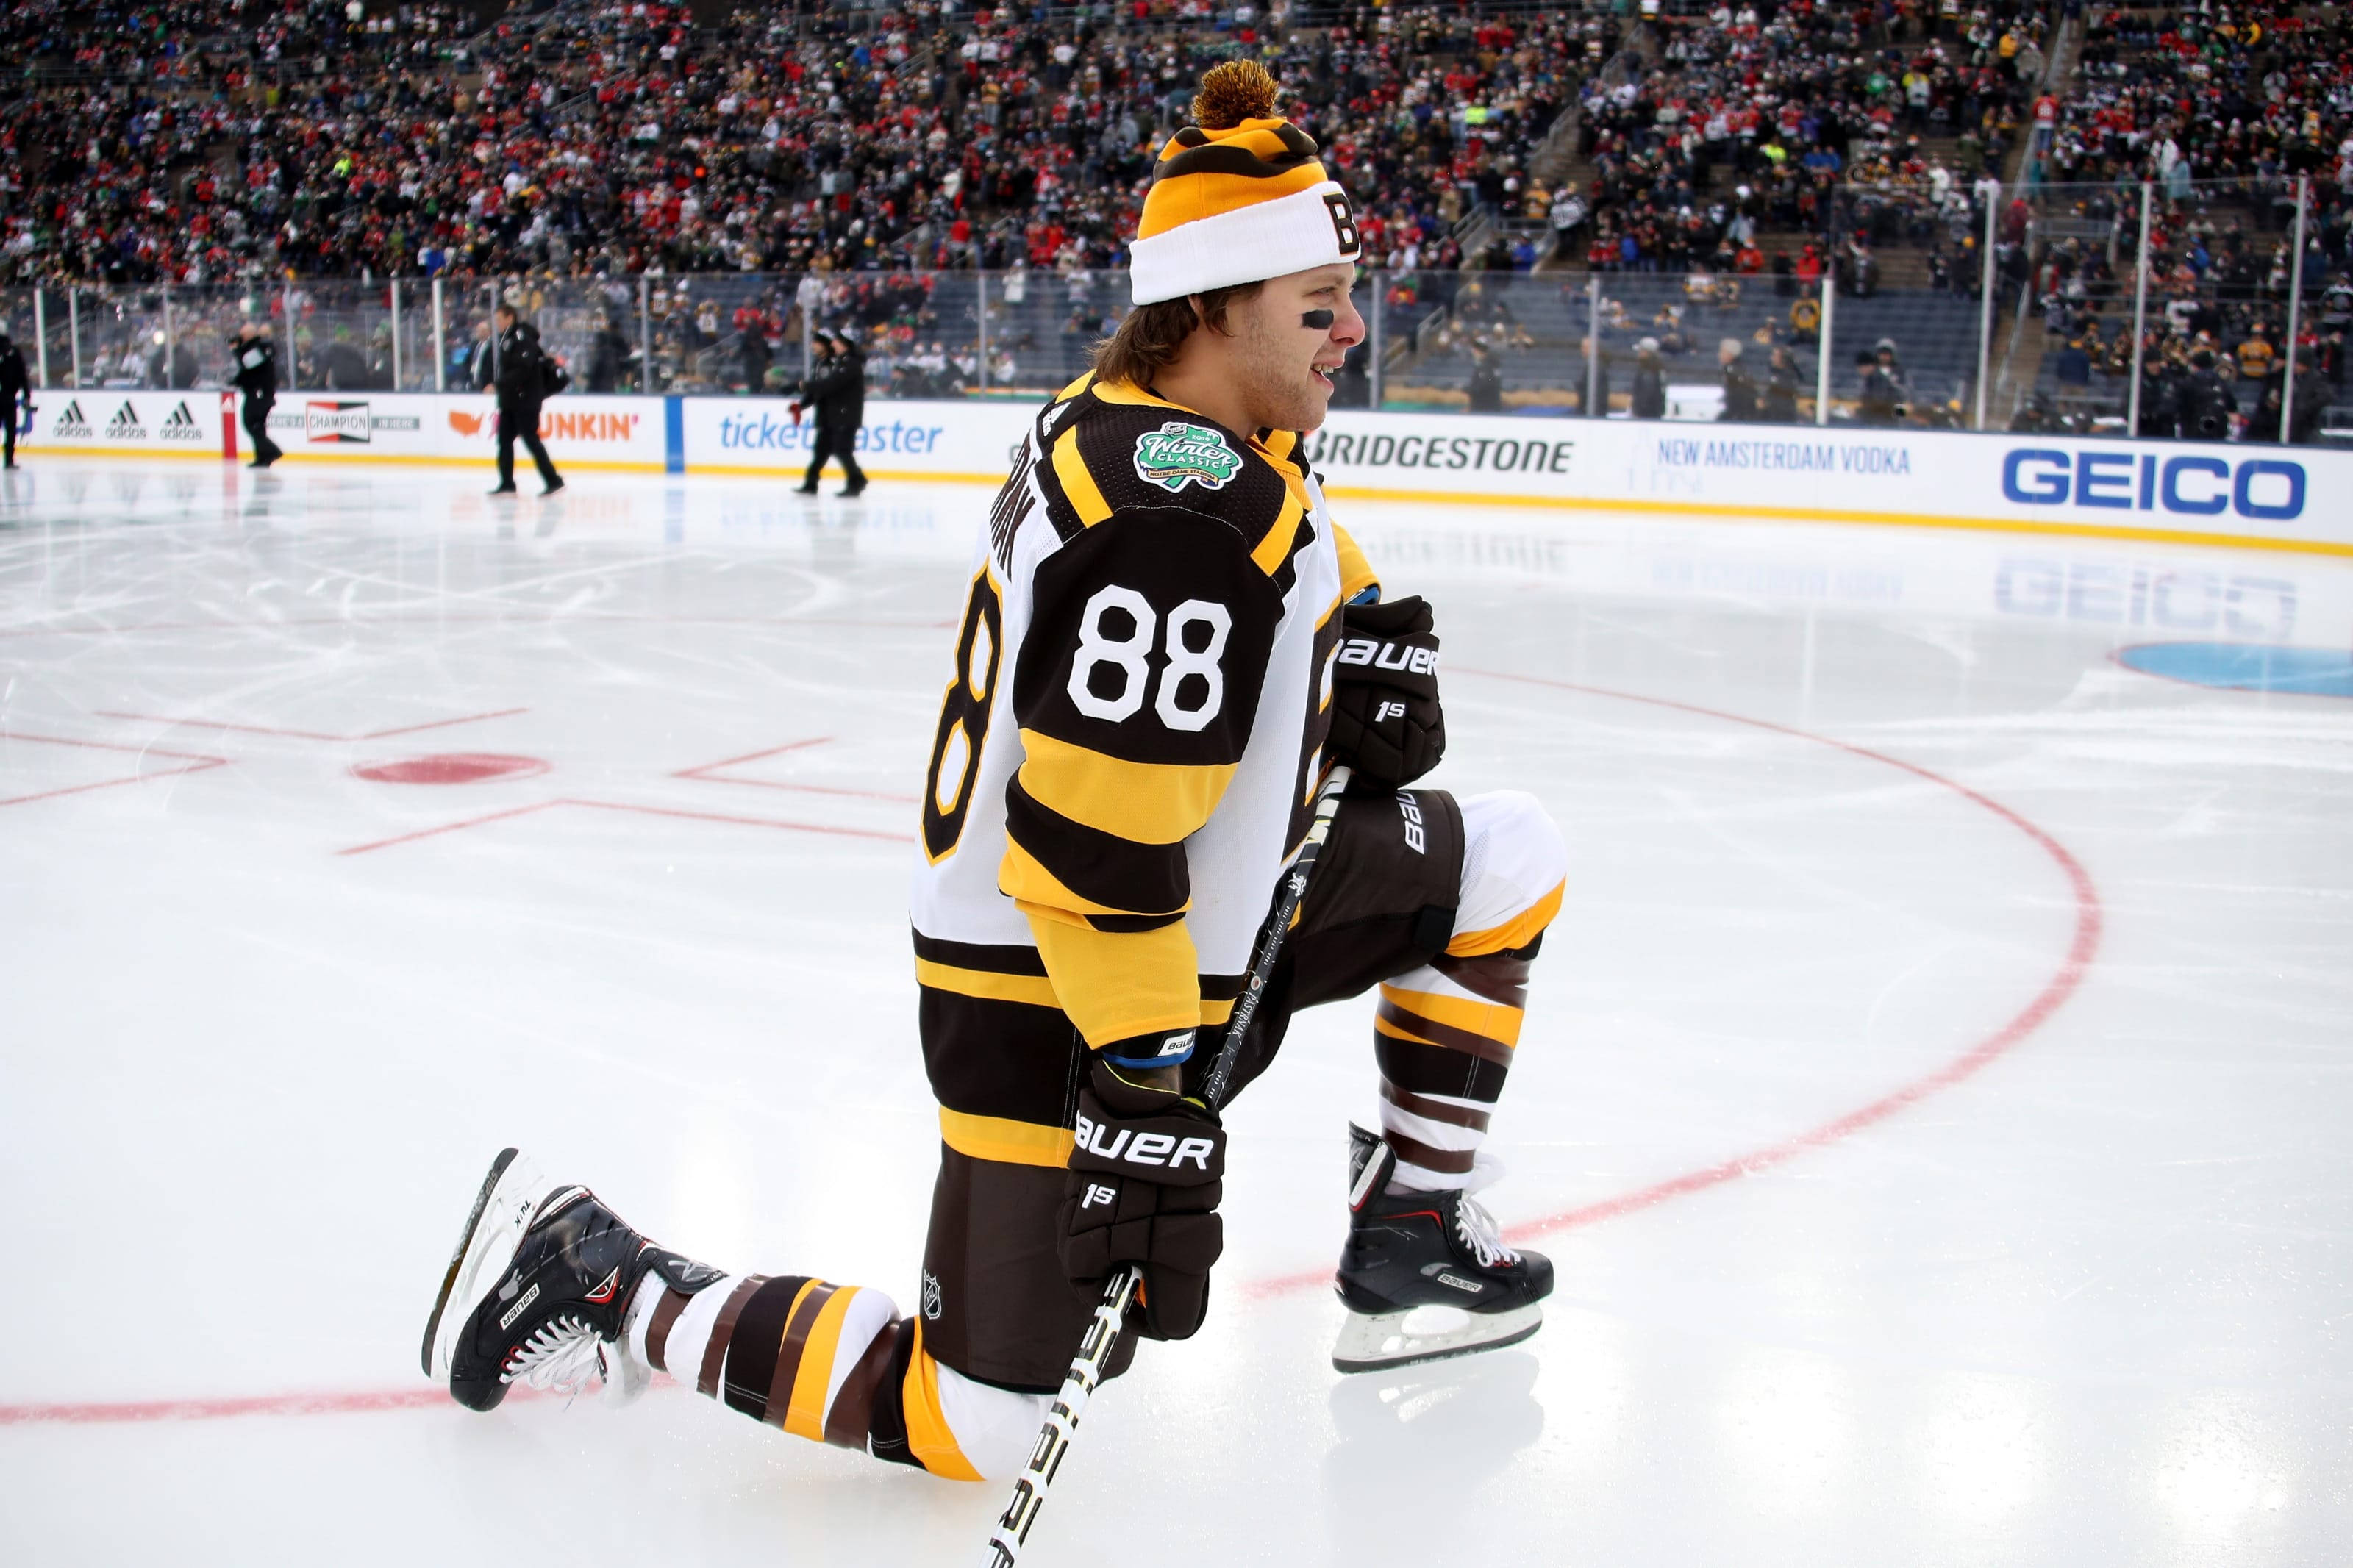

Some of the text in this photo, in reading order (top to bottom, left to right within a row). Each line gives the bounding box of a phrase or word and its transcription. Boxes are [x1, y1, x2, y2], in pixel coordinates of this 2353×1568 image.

[1323, 191, 1360, 254] B
[53, 424, 93, 437] adidas
[105, 425, 146, 439] adidas
[160, 426, 202, 440] adidas
[309, 415, 366, 430] CHAMPION
[538, 412, 638, 440] UNKIN'
[720, 412, 943, 453] ticketaster
[1146, 435, 1233, 467] Winter
[1157, 453, 1221, 470] CLASSIC
[1658, 439, 1911, 475] NEW AMSTERDAM VODKA
[2002, 448, 2306, 520] GEICO
[1067, 584, 1232, 732] 88
[1333, 638, 1439, 676] AUER
[1074, 1109, 1214, 1170] AUER
[1440, 1275, 1479, 1292] BAUER
[502, 1287, 538, 1326] BAUER
